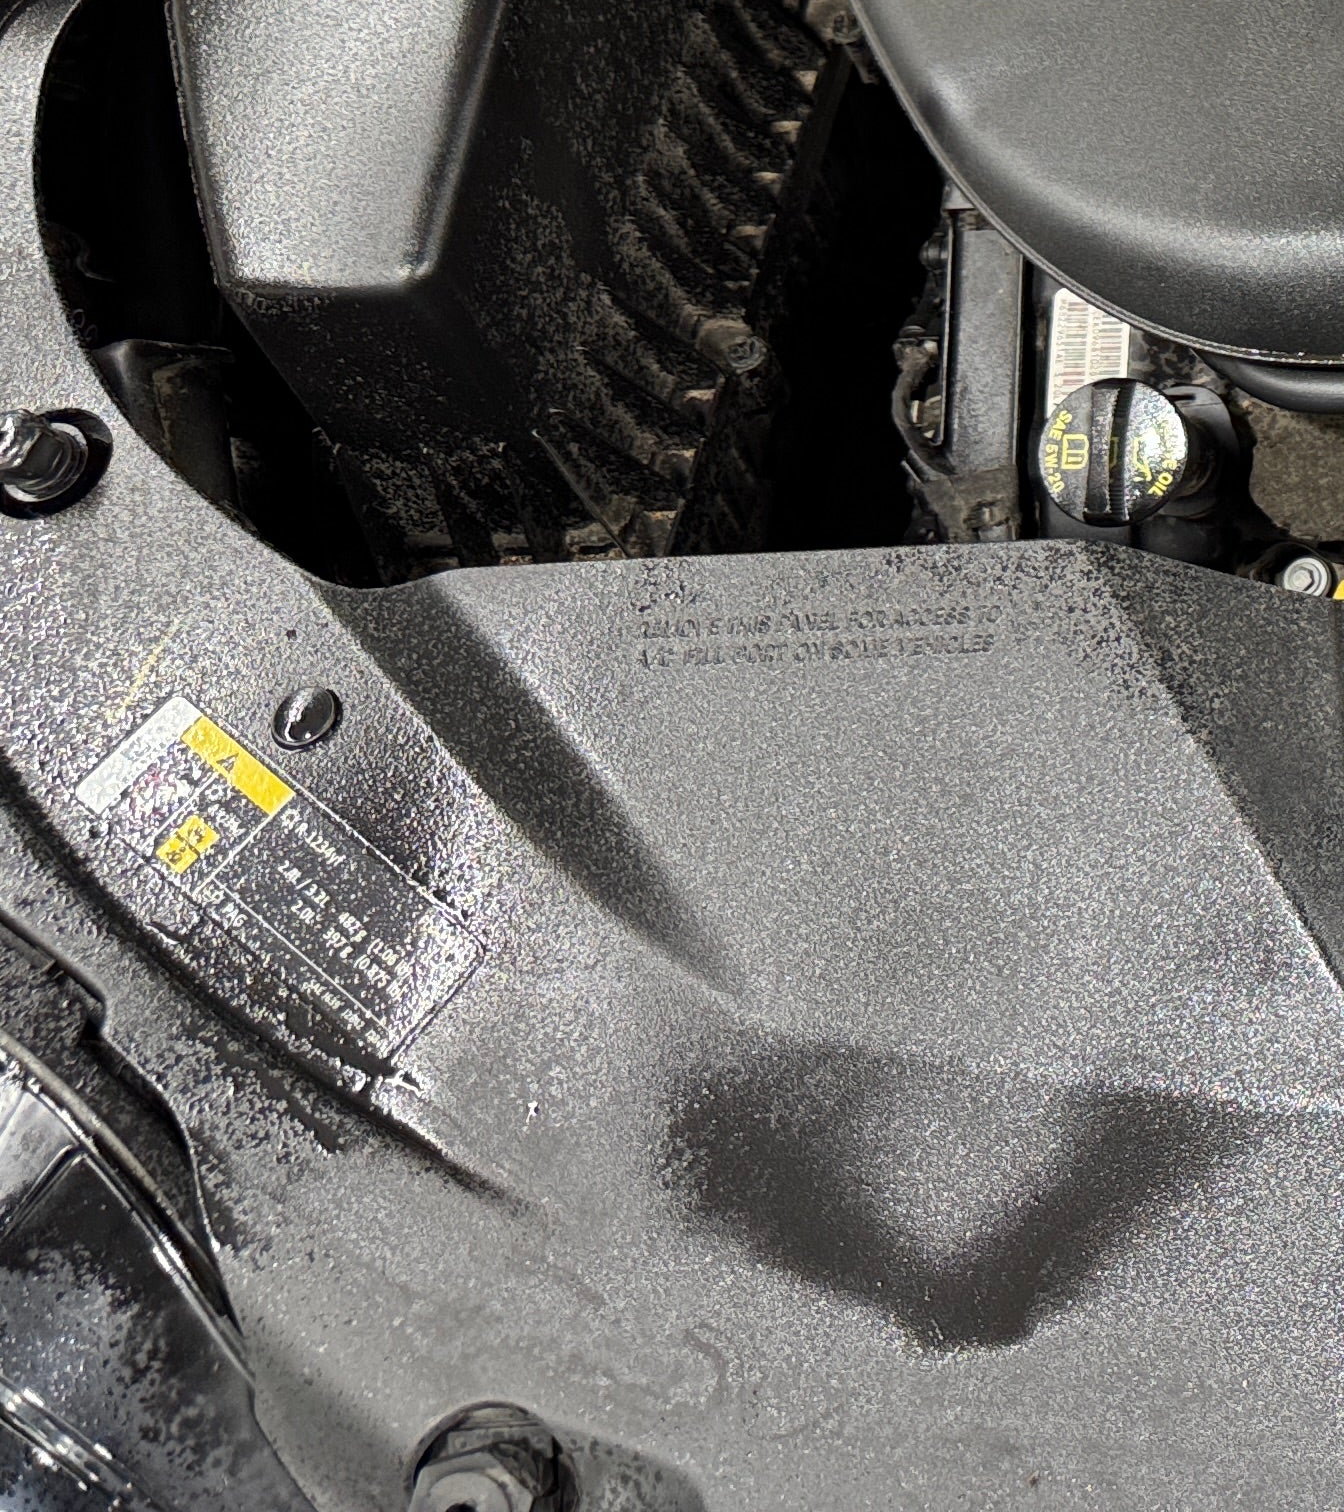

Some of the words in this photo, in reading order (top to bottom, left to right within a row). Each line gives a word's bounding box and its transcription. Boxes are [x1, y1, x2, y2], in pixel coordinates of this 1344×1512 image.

[1049, 410, 1072, 440] SAE
[1044, 444, 1065, 494] 5W-20
[1147, 472, 1173, 496] OIL
